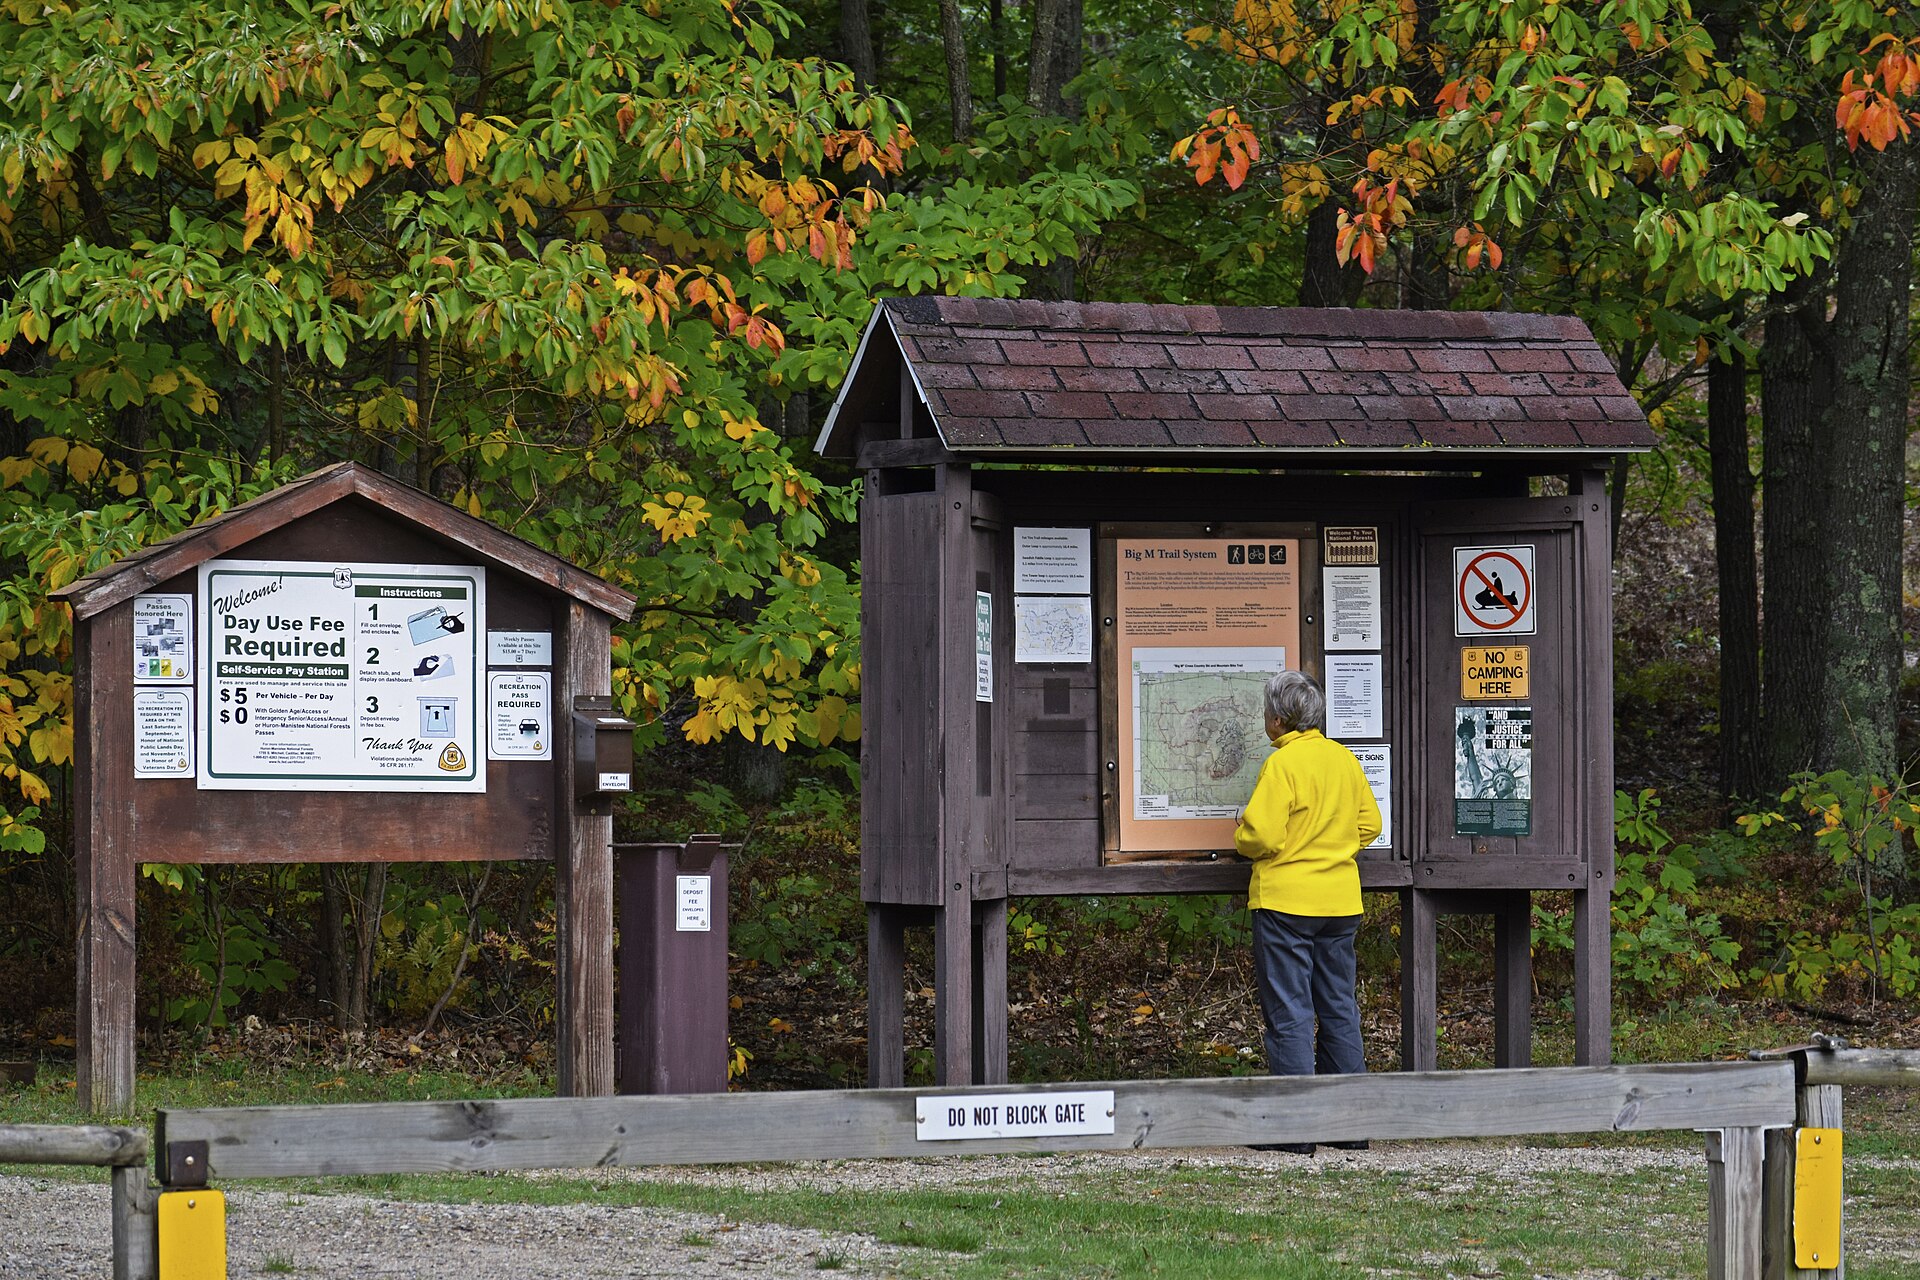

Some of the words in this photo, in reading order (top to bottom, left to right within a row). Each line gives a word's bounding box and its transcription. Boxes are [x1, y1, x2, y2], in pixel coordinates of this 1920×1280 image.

[1125, 550, 1142, 560] Big
[1145, 550, 1154, 558] M
[1158, 550, 1180, 558] Trail
[1183, 550, 1217, 561] System
[214, 572, 283, 615] Welcome!
[380, 588, 442, 598] Instructions
[369, 604, 378, 620] 1
[224, 615, 260, 633] Day
[267, 616, 303, 630] Use
[311, 617, 344, 631] Fee
[225, 635, 345, 660] Required
[367, 648, 379, 664] 2
[1485, 652, 1505, 664] NO
[221, 666, 283, 674] Self-Service
[286, 666, 304, 676] Pay
[307, 667, 344, 676] Station
[1468, 666, 1523, 679] CAMPING
[1480, 682, 1511, 694] HERE
[366, 696, 379, 713] 3
[1492, 725, 1522, 734] JUSTICE
[362, 738, 404, 750] Thank
[407, 738, 433, 754] You
[1493, 740, 1507, 749] FOR
[949, 1108, 965, 1127] DO
[974, 1107, 999, 1126] NOT
[1007, 1105, 1047, 1125] BLOCK
[1056, 1104, 1085, 1123] GATE
